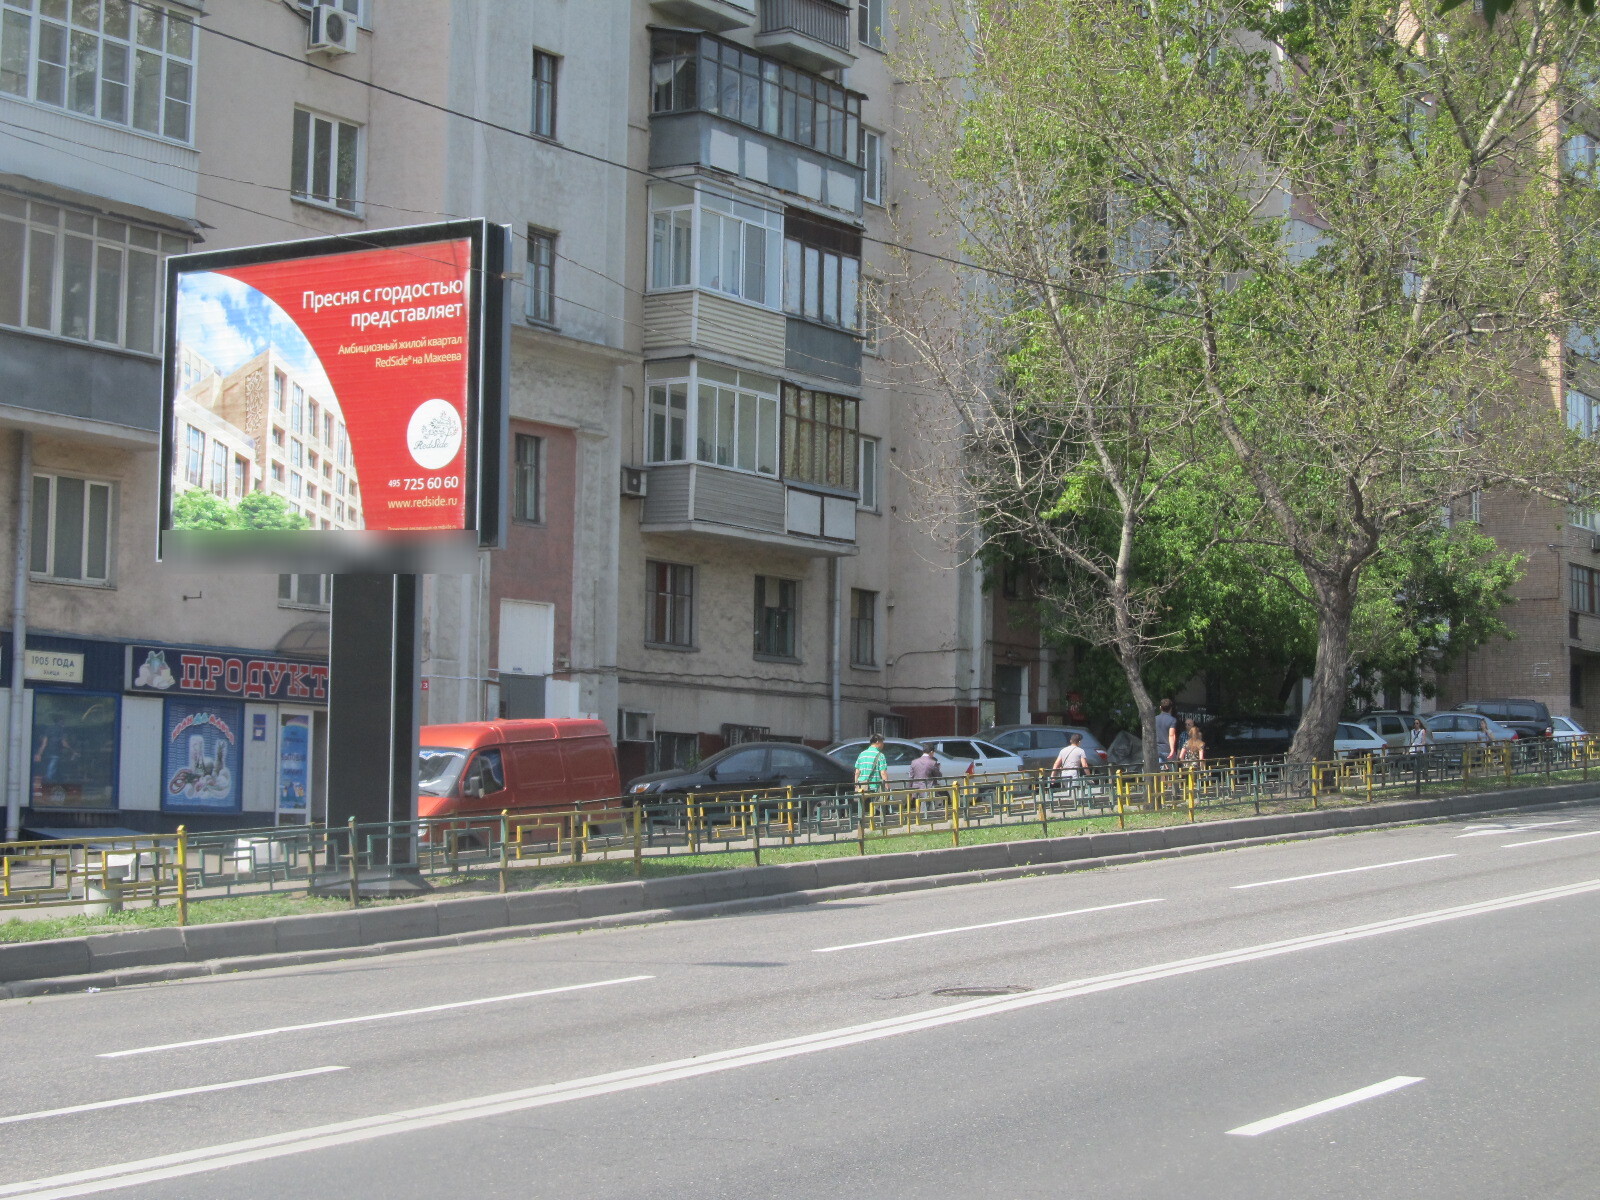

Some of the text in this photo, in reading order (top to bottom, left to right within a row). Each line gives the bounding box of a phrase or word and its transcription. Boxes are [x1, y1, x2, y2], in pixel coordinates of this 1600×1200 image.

[303, 279, 464, 313] Пресня с гордостью
[351, 303, 463, 331] представляет
[338, 336, 463, 355] Амбициозный жилой квартал
[413, 355, 423, 365] на
[423, 352, 462, 364] Макеева
[413, 438, 449, 450] RedSide
[388, 476, 459, 491] 495 725 60 60
[387, 496, 458, 509] www.redside.ru
[31, 655, 75, 669] 1905 ГОДА
[180, 654, 329, 699] ПРОДУКТ
